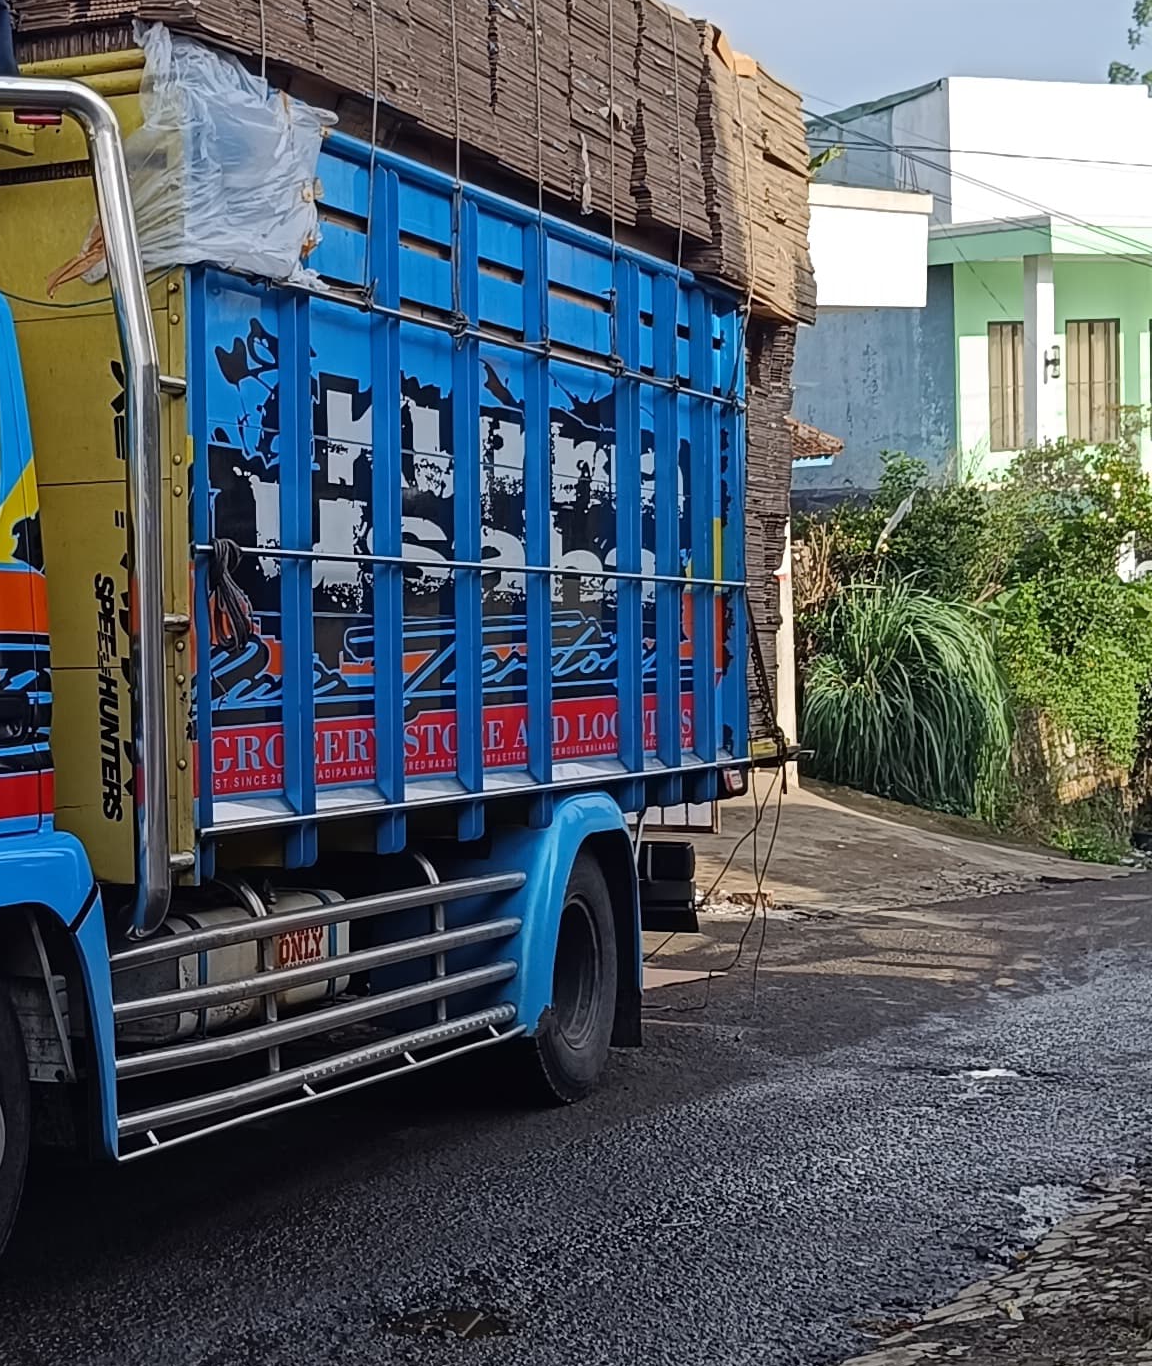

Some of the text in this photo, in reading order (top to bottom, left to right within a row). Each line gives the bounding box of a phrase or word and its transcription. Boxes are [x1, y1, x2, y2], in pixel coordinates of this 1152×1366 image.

[212, 729, 375, 774] GROER
[404, 720, 504, 757] STOE
[513, 715, 569, 749] AD
[279, 925, 324, 966] ONLY
